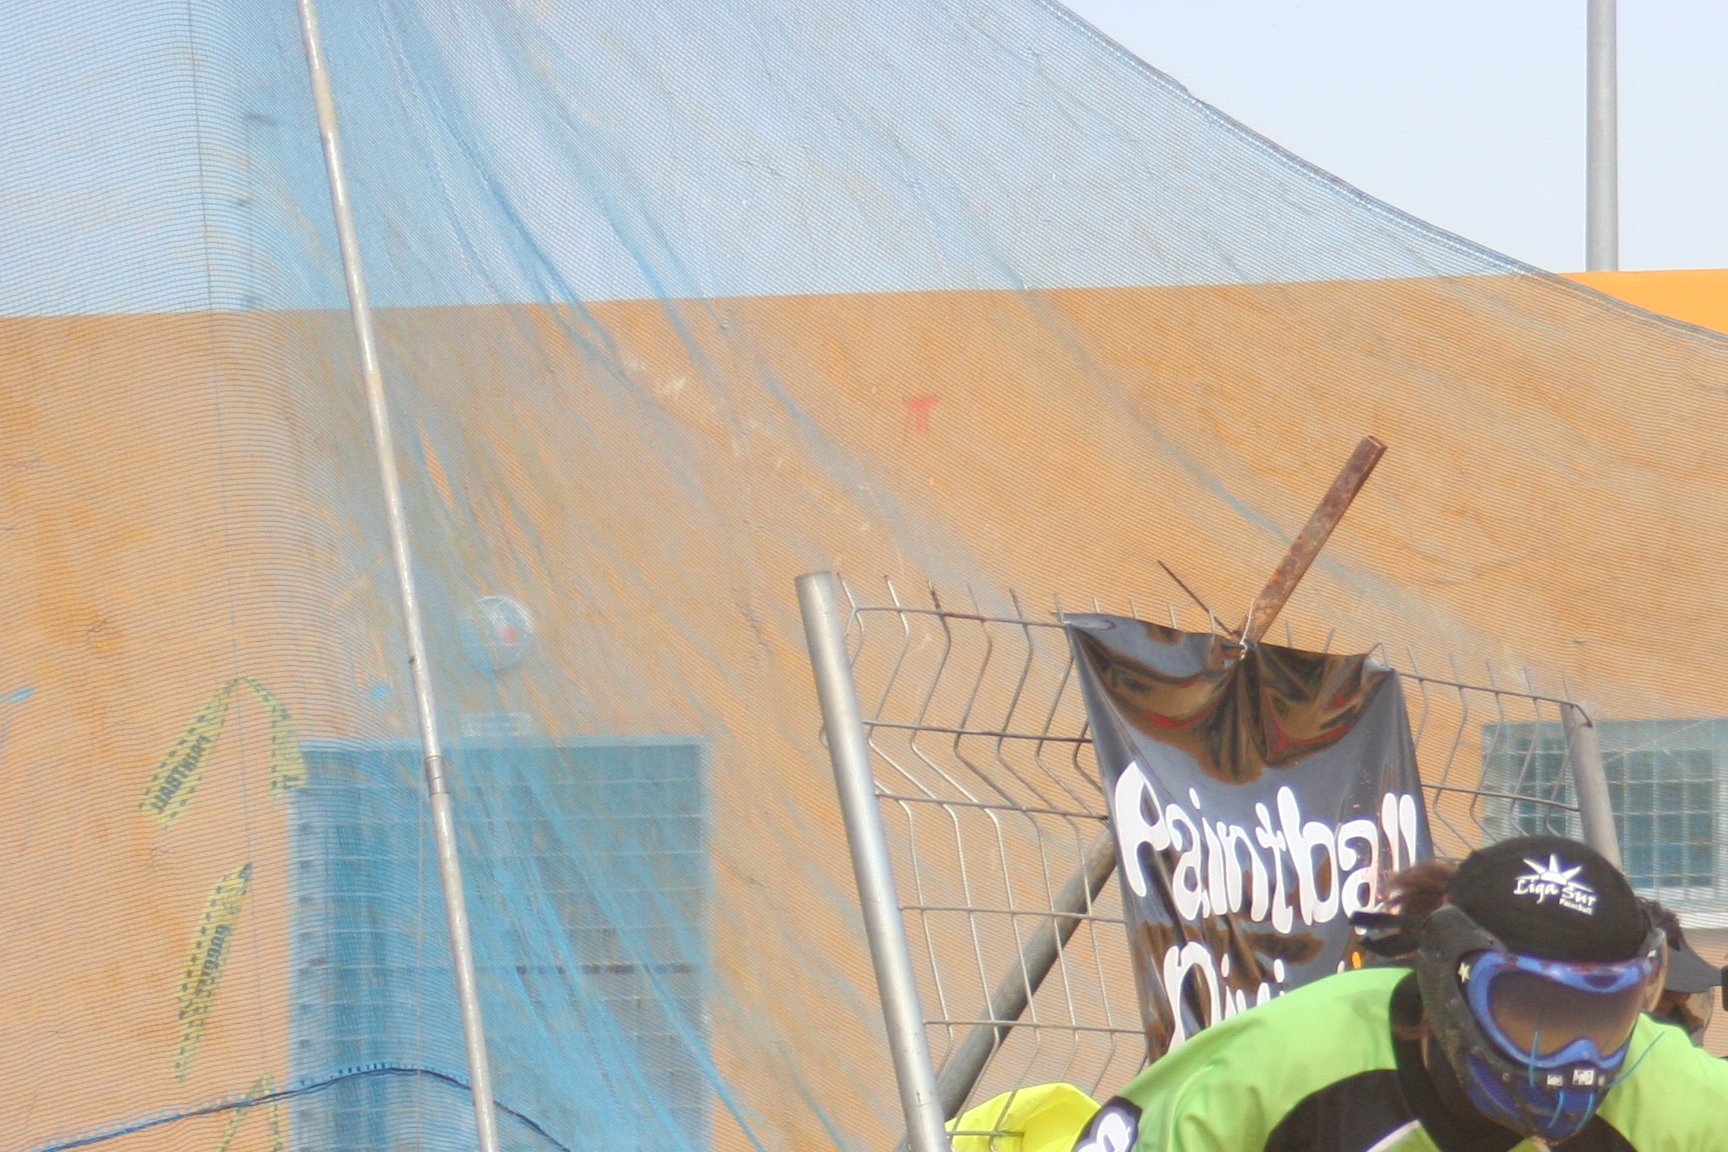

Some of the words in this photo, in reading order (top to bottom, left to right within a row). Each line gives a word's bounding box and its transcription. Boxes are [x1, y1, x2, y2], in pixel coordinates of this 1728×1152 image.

[1114, 760, 1419, 935] Paintball
[1513, 879, 1559, 905] Liga
[1561, 885, 1598, 907] Sur
